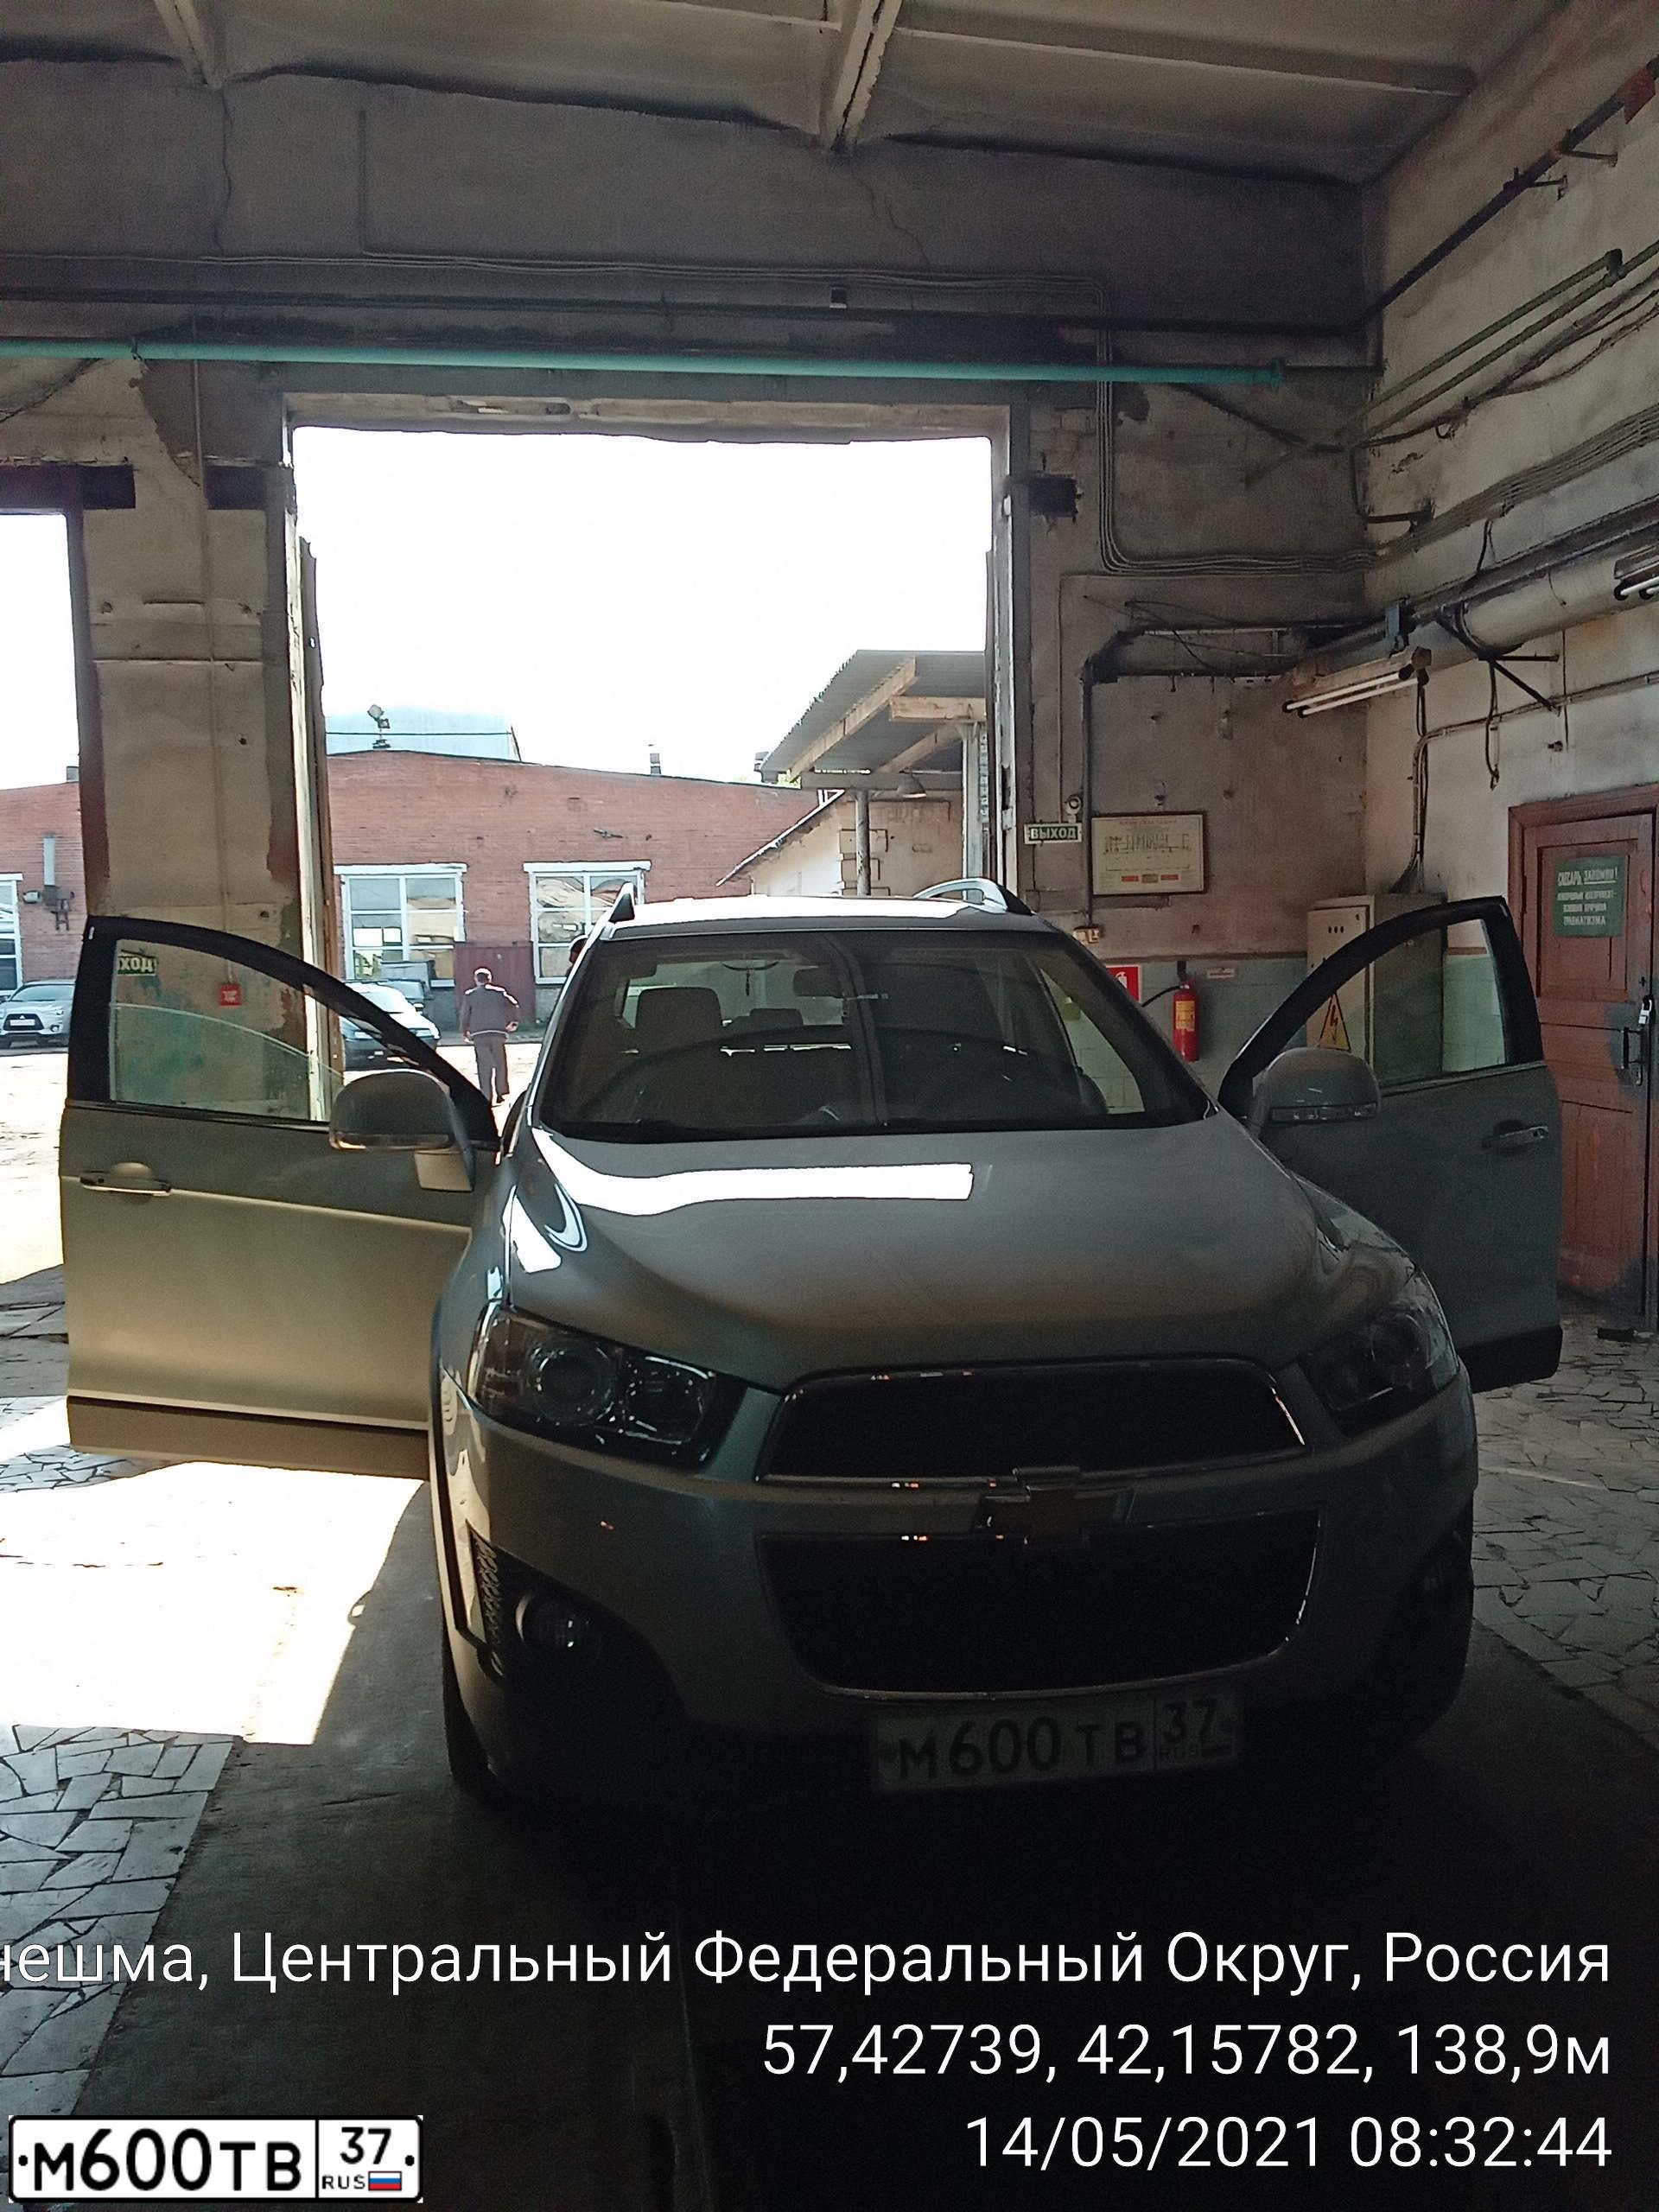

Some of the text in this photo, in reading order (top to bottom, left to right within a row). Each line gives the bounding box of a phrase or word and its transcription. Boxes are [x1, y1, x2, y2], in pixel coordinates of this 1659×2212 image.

[1030, 827, 1077, 839] ВЫХОД
[118, 957, 153, 972] ХОД
[899, 1699, 1217, 1779] М600ТВ 37
